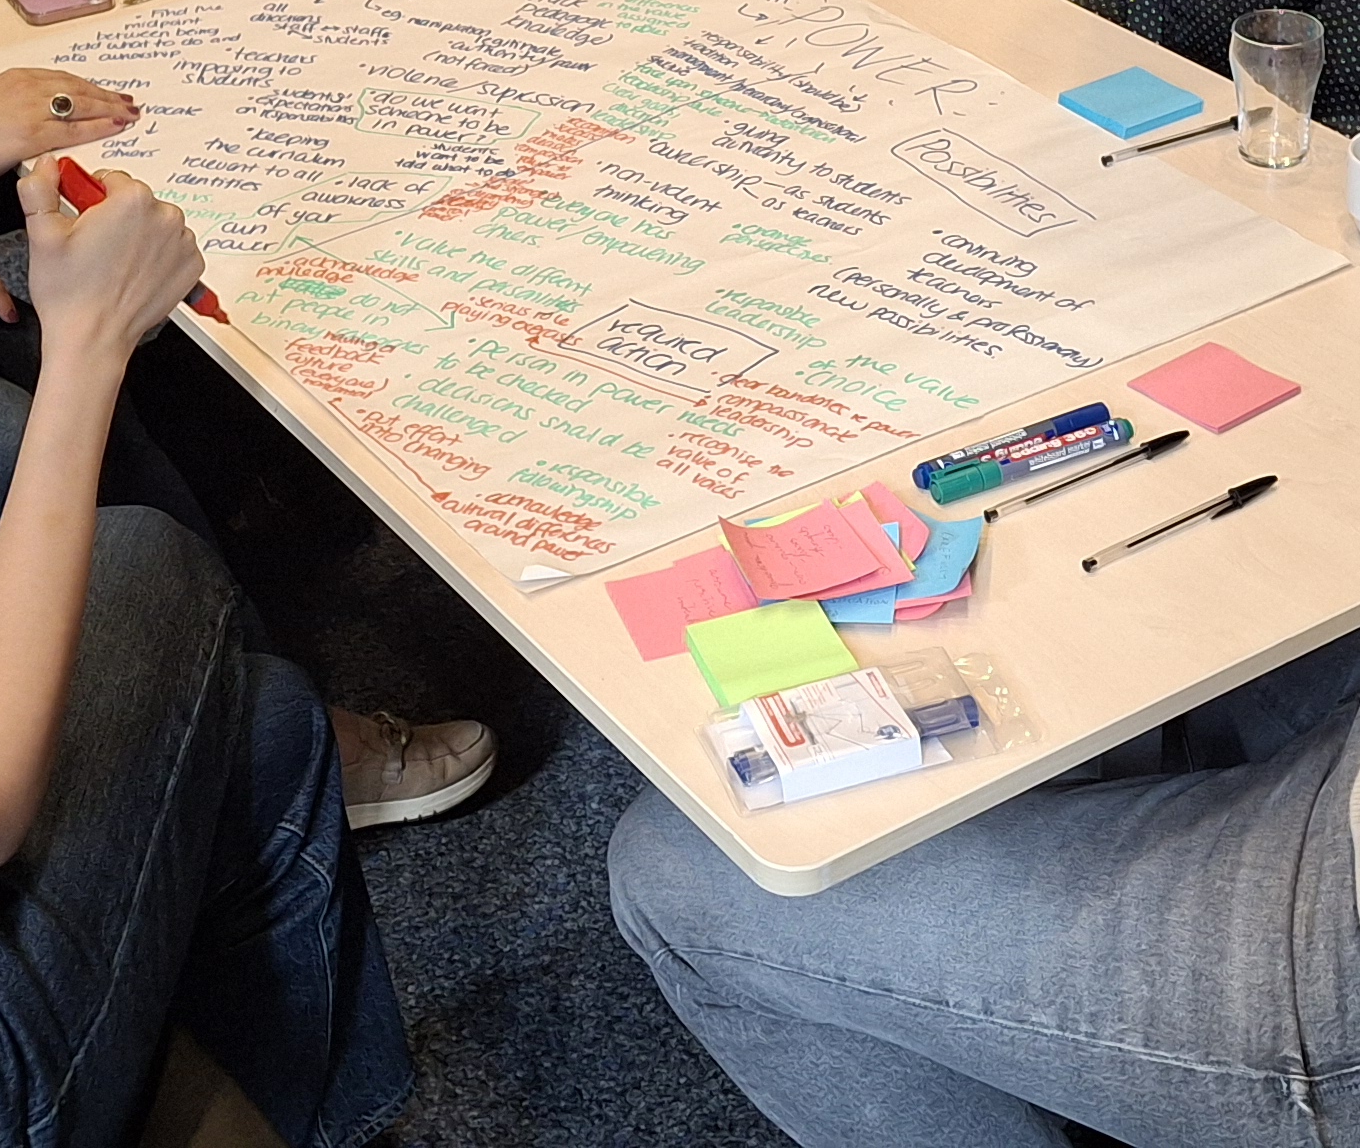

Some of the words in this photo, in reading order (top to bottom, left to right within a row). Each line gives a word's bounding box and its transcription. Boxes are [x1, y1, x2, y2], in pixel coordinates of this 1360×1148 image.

[151, 7, 189, 19] Find
[262, 2, 290, 13] all
[96, 28, 171, 41] between
[176, 26, 220, 38] being
[106, 38, 150, 50] what
[154, 38, 176, 49] to
[180, 36, 205, 47] do
[210, 33, 242, 45] and
[313, 36, 391, 47] students
[233, 46, 319, 65] teachers
[778, 5, 977, 115] POWER
[181, 73, 275, 89] students
[278, 65, 303, 77] to
[374, 91, 408, 106] do
[411, 97, 440, 110] we
[447, 100, 504, 119] want
[364, 104, 454, 125] someone
[457, 117, 482, 131] to
[484, 120, 512, 137] be
[371, 117, 398, 131] in
[101, 137, 139, 149] and
[250, 128, 330, 151] keeping
[416, 150, 461, 163] want
[483, 153, 507, 166] be
[166, 171, 263, 192] identities
[265, 164, 290, 179] to
[292, 168, 325, 183] all
[475, 167, 495, 178] to
[904, 138, 1056, 224] Possibilities
[348, 174, 398, 193] lack
[403, 180, 436, 196] of
[810, 162, 835, 178] to
[828, 172, 913, 206] students
[256, 202, 292, 219] of
[760, 196, 788, 211] as
[812, 194, 893, 226] students
[630, 218, 677, 240] has
[365, 248, 430, 271] skills
[426, 266, 480, 285] and
[349, 293, 382, 309] do
[807, 284, 870, 311] new
[1054, 298, 1096, 314] of
[360, 313, 391, 327] in
[439, 300, 513, 328] playing
[705, 300, 828, 351] leadership
[608, 318, 728, 364] required
[596, 335, 687, 376] action
[433, 351, 462, 371] to
[465, 360, 496, 380] be
[496, 371, 593, 414] checked
[562, 369, 589, 387] in
[587, 380, 675, 415] power
[804, 369, 908, 413] choice
[904, 372, 980, 410] value
[709, 405, 814, 449] leadership
[620, 441, 656, 461] be
[678, 430, 764, 469] recognise
[1010, 437, 1062, 461] edding
[1062, 424, 1098, 444] 360
[656, 458, 692, 477] all
[667, 445, 711, 471] value
[716, 467, 751, 485] of
